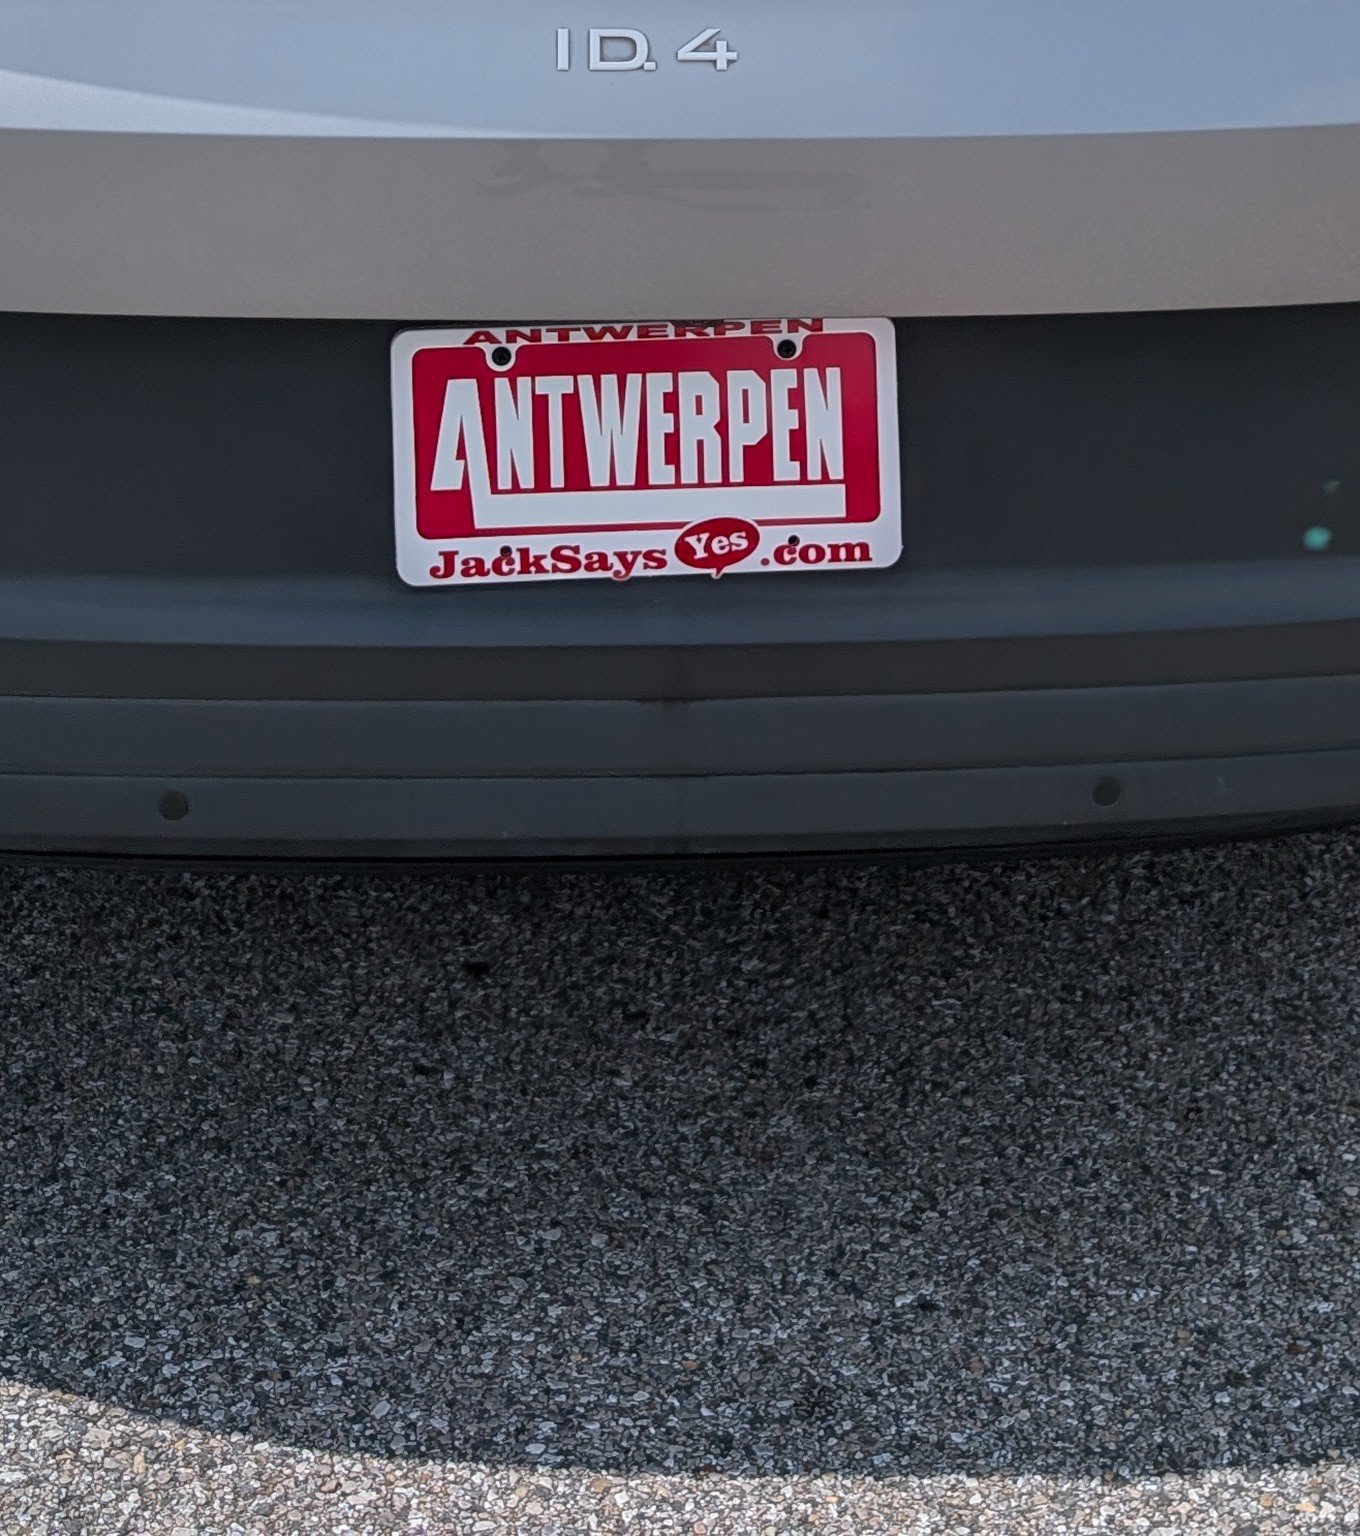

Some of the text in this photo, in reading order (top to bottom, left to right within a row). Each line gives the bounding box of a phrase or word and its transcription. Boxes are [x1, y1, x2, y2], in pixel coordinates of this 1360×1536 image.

[464, 318, 824, 345] ANTWERPEN
[430, 367, 846, 530] ANTWERPEN
[429, 545, 667, 580] JackSays
[685, 530, 749, 560] Yes
